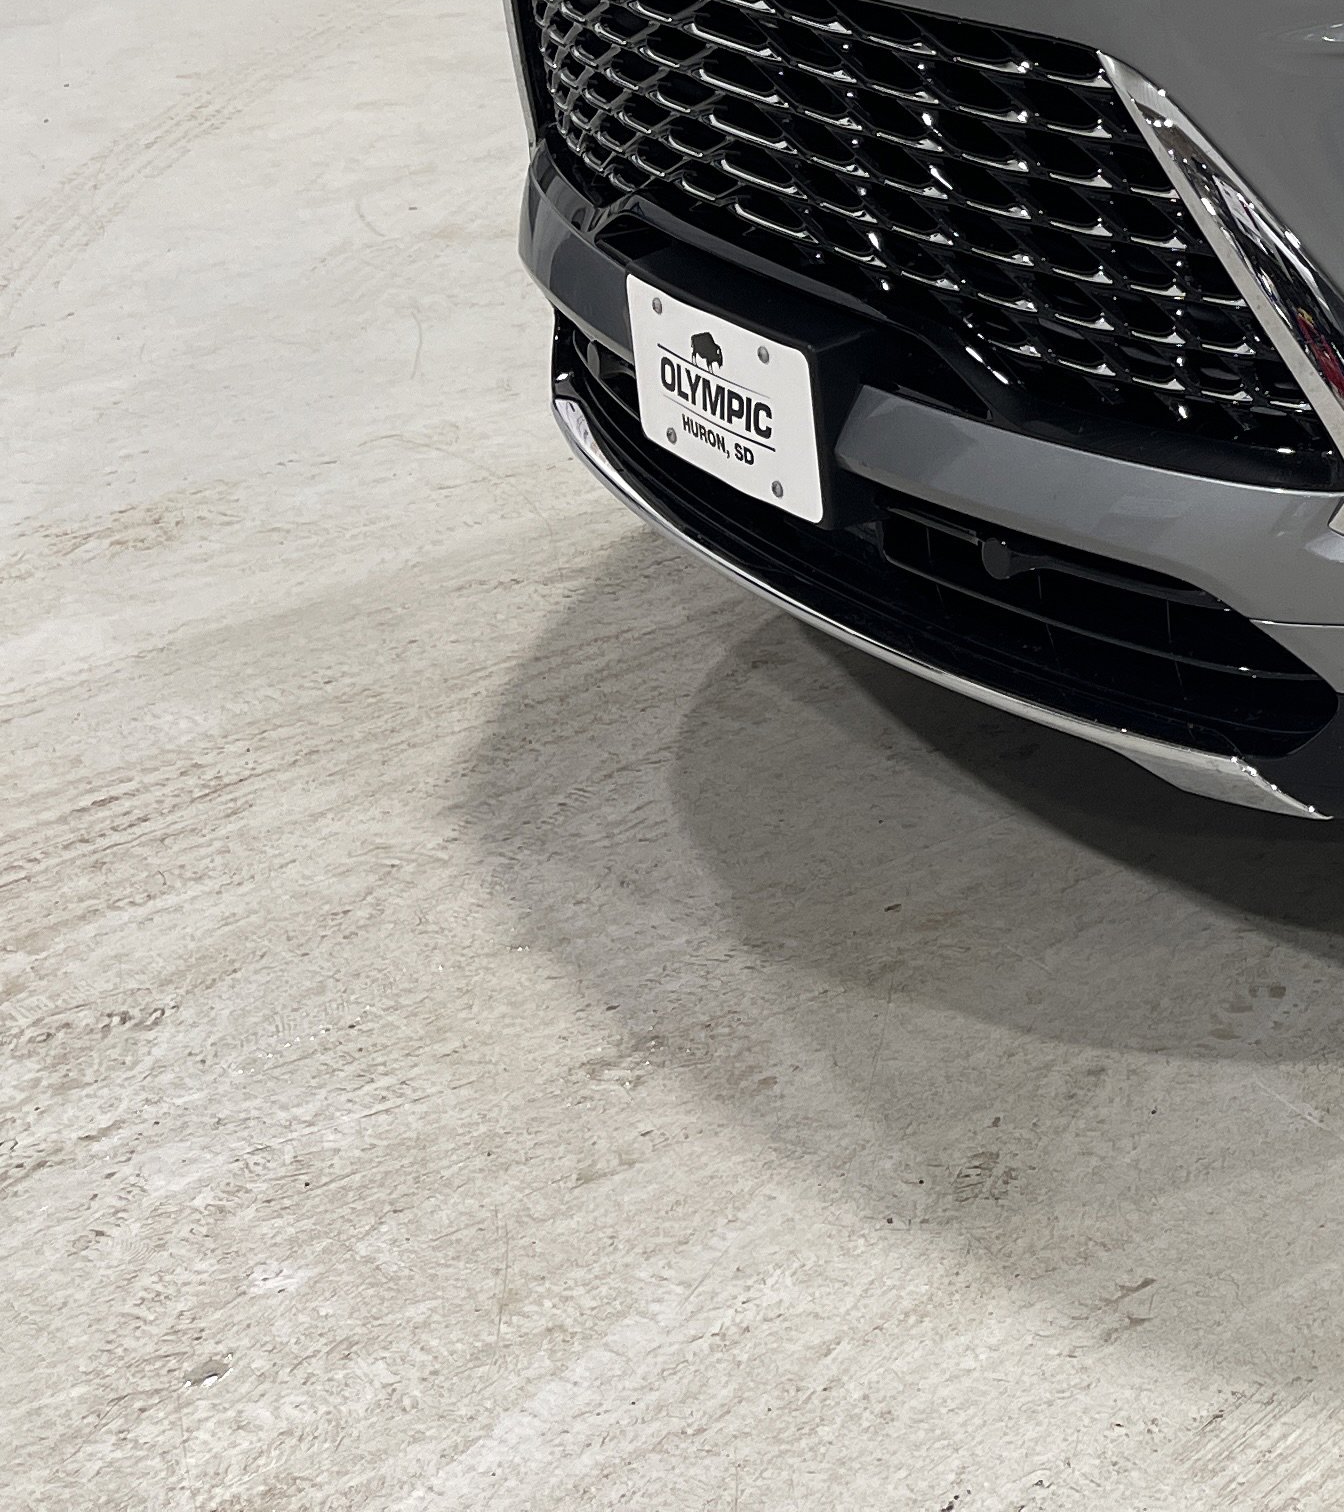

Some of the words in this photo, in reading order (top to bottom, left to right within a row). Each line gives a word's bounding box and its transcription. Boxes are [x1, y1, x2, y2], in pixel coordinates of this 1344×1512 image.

[660, 356, 773, 439] OLYMPIC
[681, 413, 731, 459] HURON,
[734, 442, 755, 466] SD
